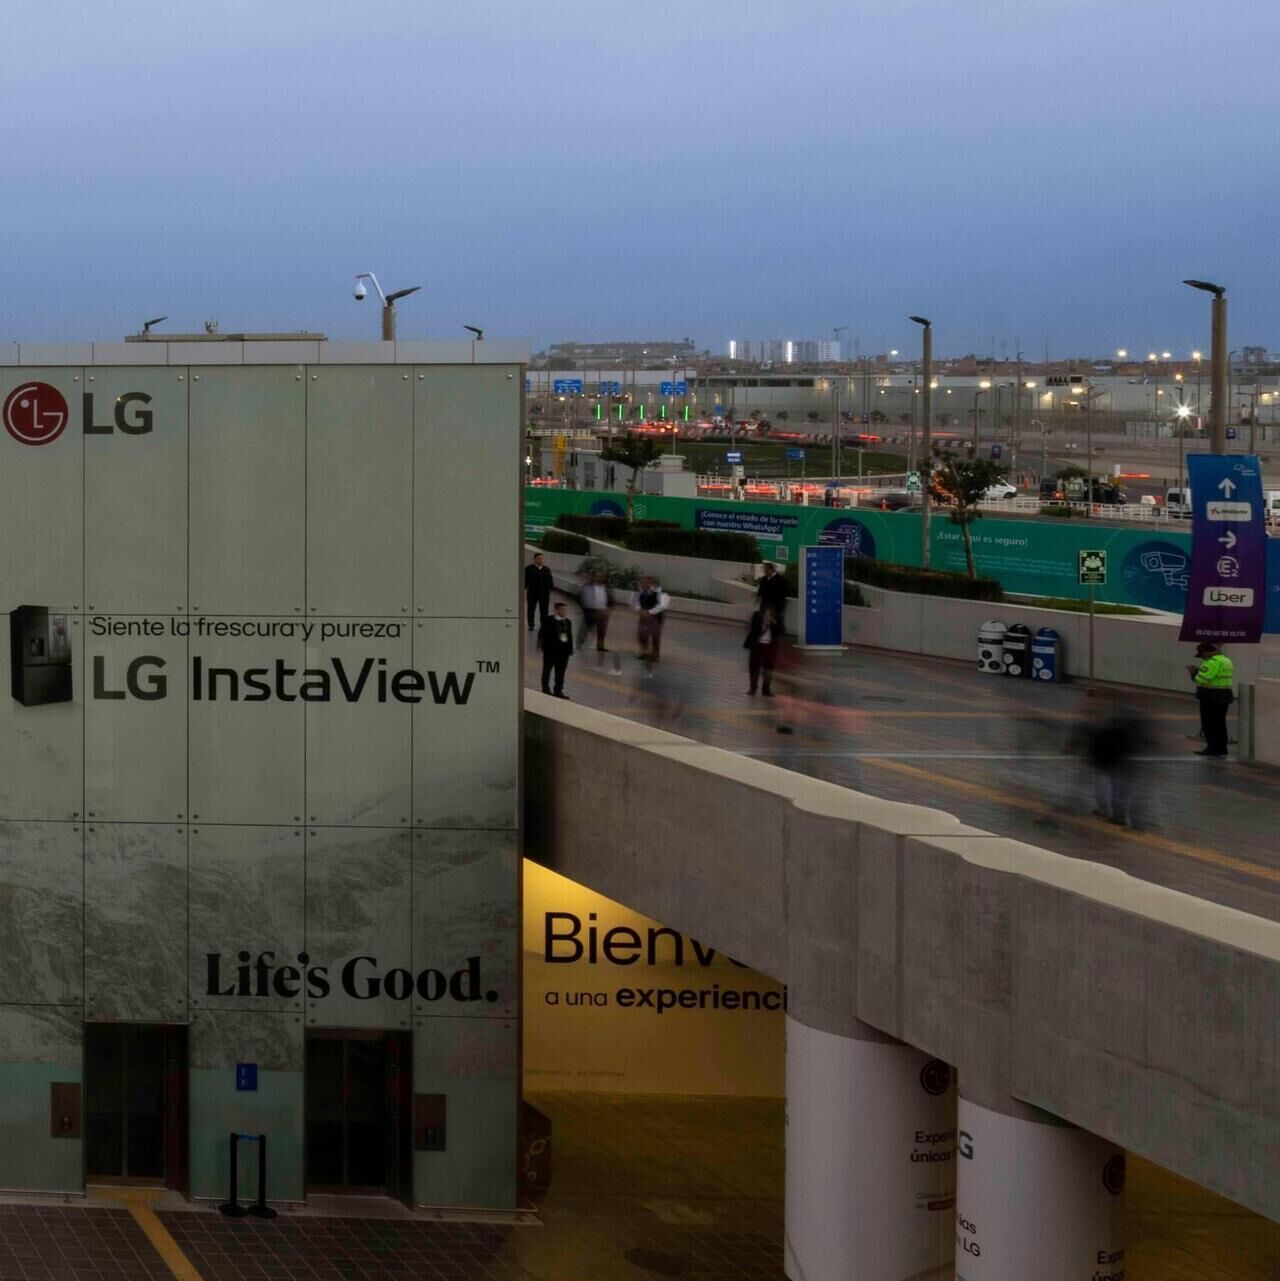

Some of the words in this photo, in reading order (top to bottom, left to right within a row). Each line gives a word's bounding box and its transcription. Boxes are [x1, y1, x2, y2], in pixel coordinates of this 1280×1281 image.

[83, 392, 153, 435] LG
[995, 536, 1028, 547] seguro!
[1209, 590, 1246, 603] Uber
[91, 616, 165, 637] Siente
[170, 617, 190, 637] la
[196, 616, 294, 638] frescura
[301, 623, 314, 641] y
[321, 622, 401, 641] pureza
[93, 656, 167, 701] LG
[206, 951, 330, 998] Life's
[341, 956, 498, 1001] Good.
[545, 991, 559, 1006] a
[565, 991, 608, 1006] una
[963, 1238, 981, 1257] LG
